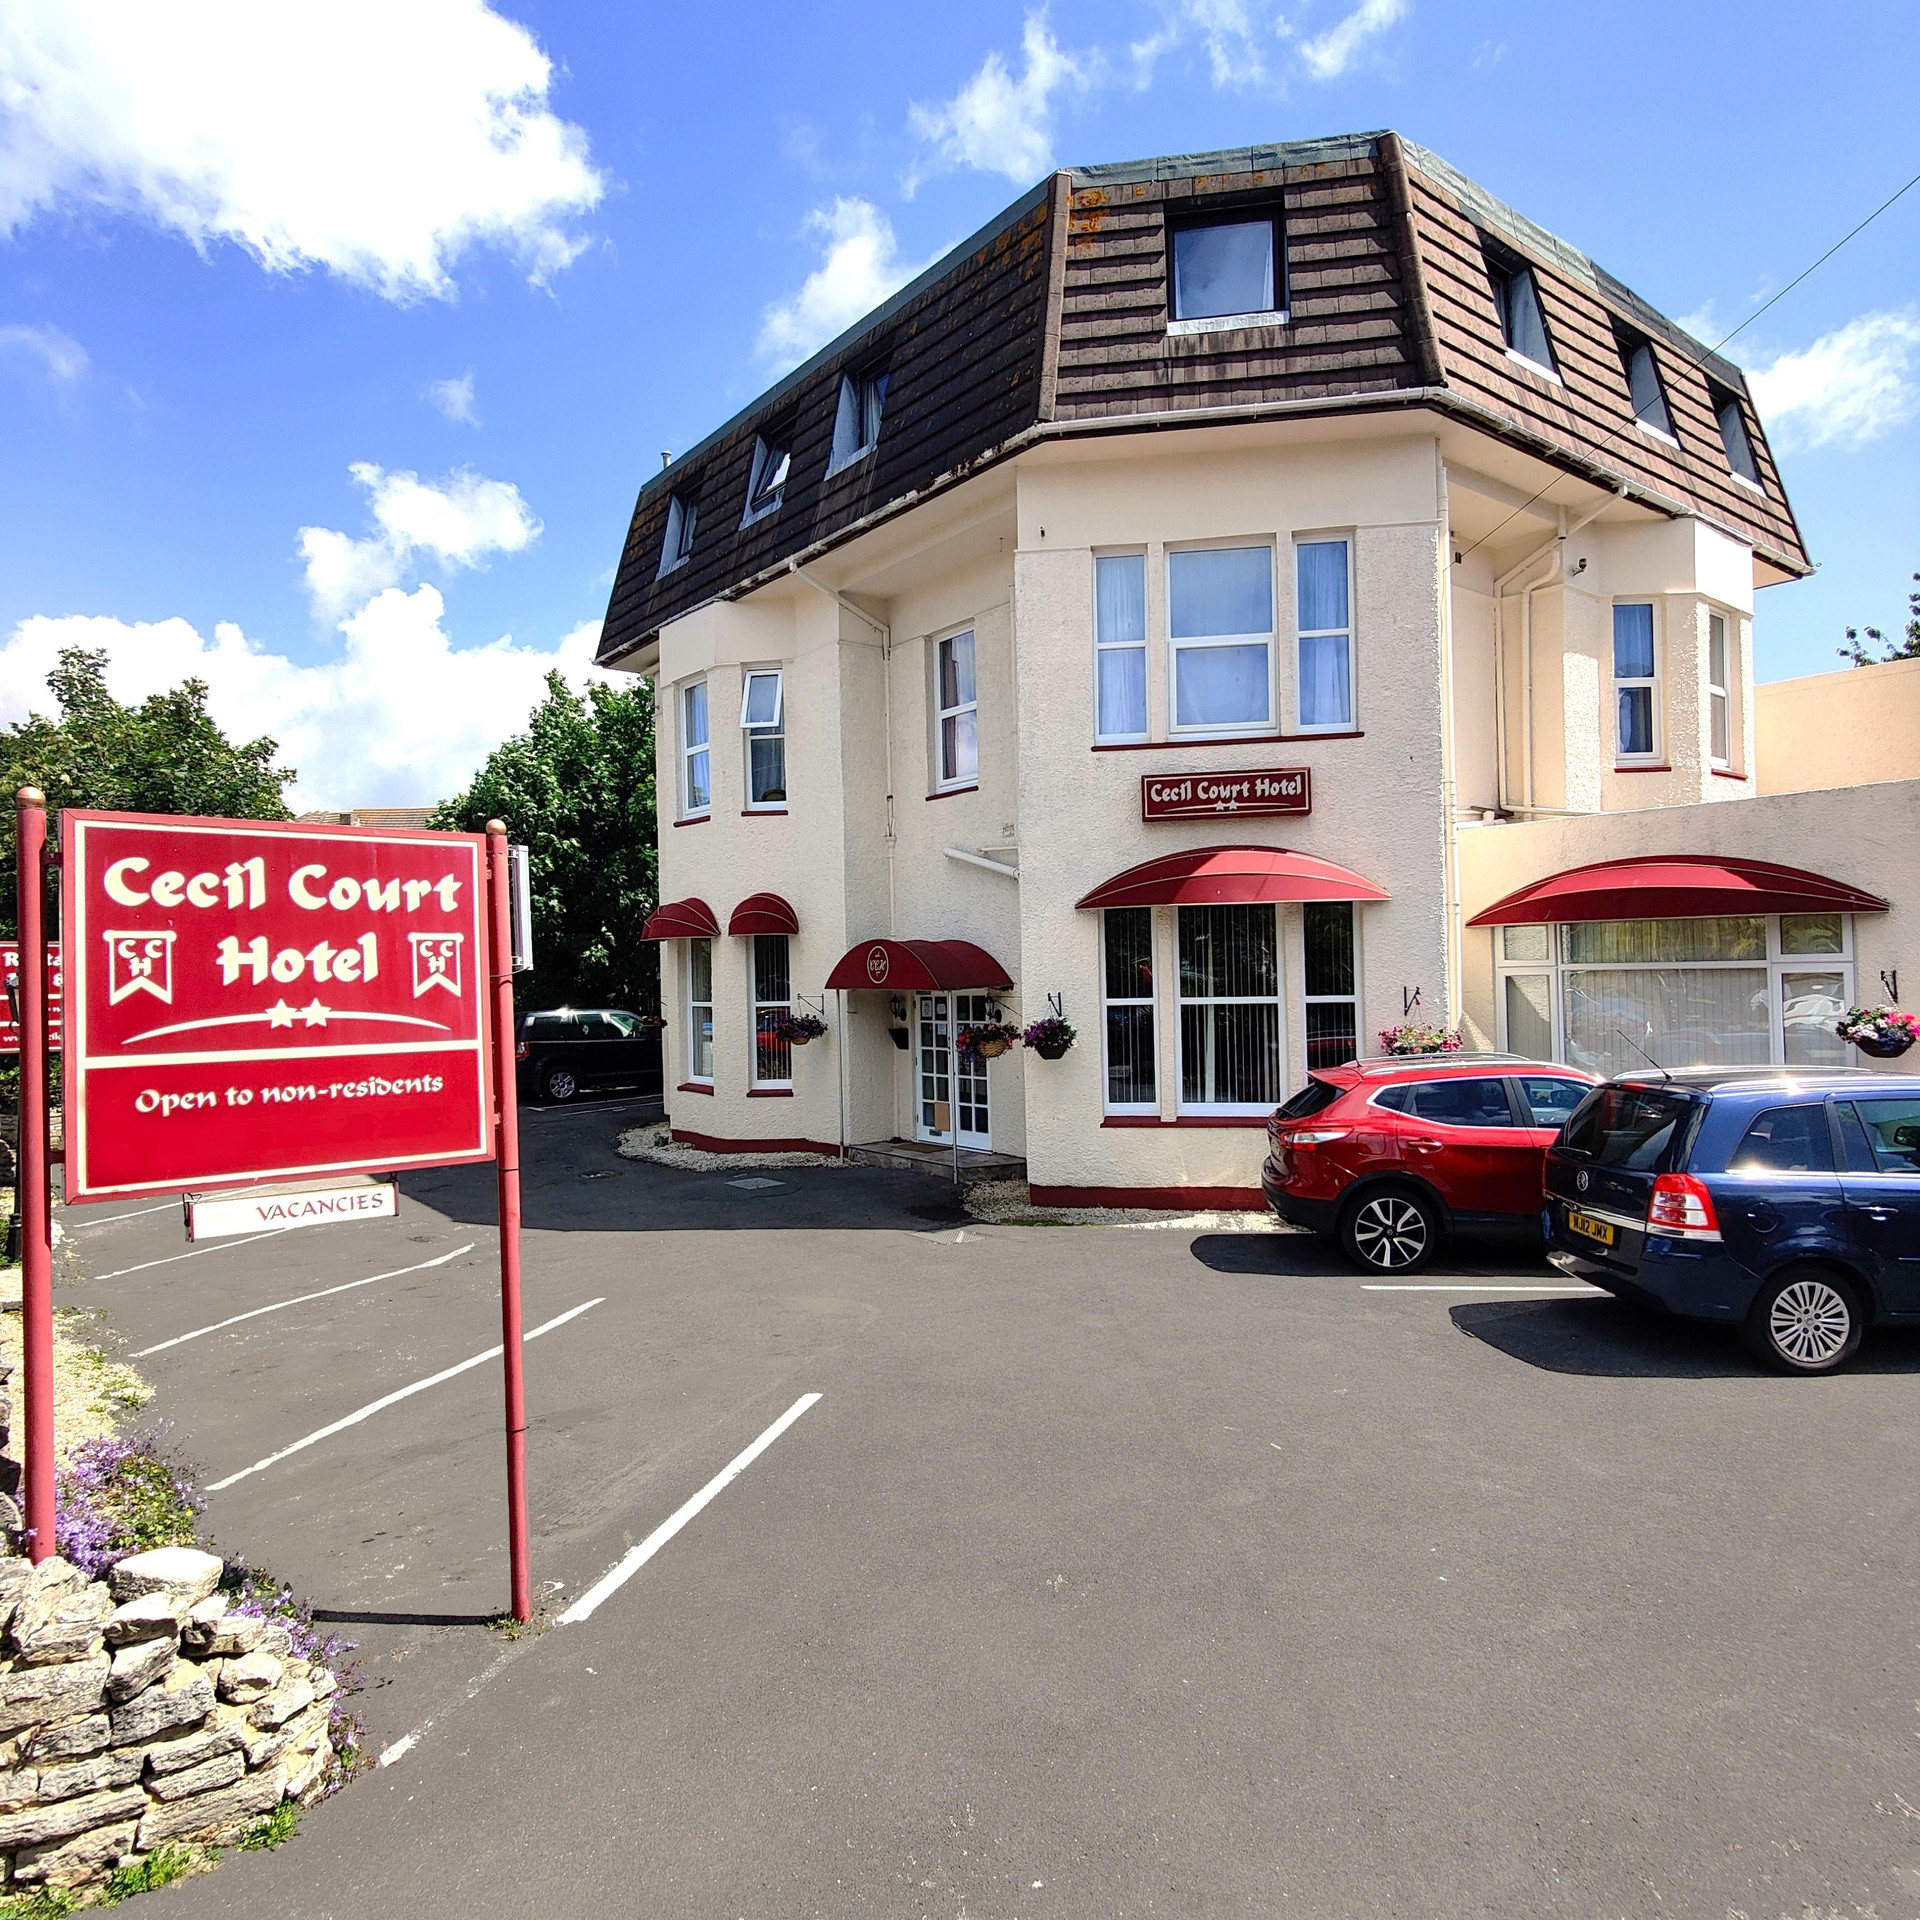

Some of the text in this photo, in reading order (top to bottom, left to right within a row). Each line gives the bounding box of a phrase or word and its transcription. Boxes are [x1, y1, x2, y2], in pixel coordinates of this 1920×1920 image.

[1150, 775, 1302, 802] Cecil Court Hotel
[104, 856, 463, 913] Cecil Court
[216, 931, 379, 986] Hotel
[135, 1074, 444, 1117] Open to non-residents
[256, 1193, 384, 1222] VACANCIES
